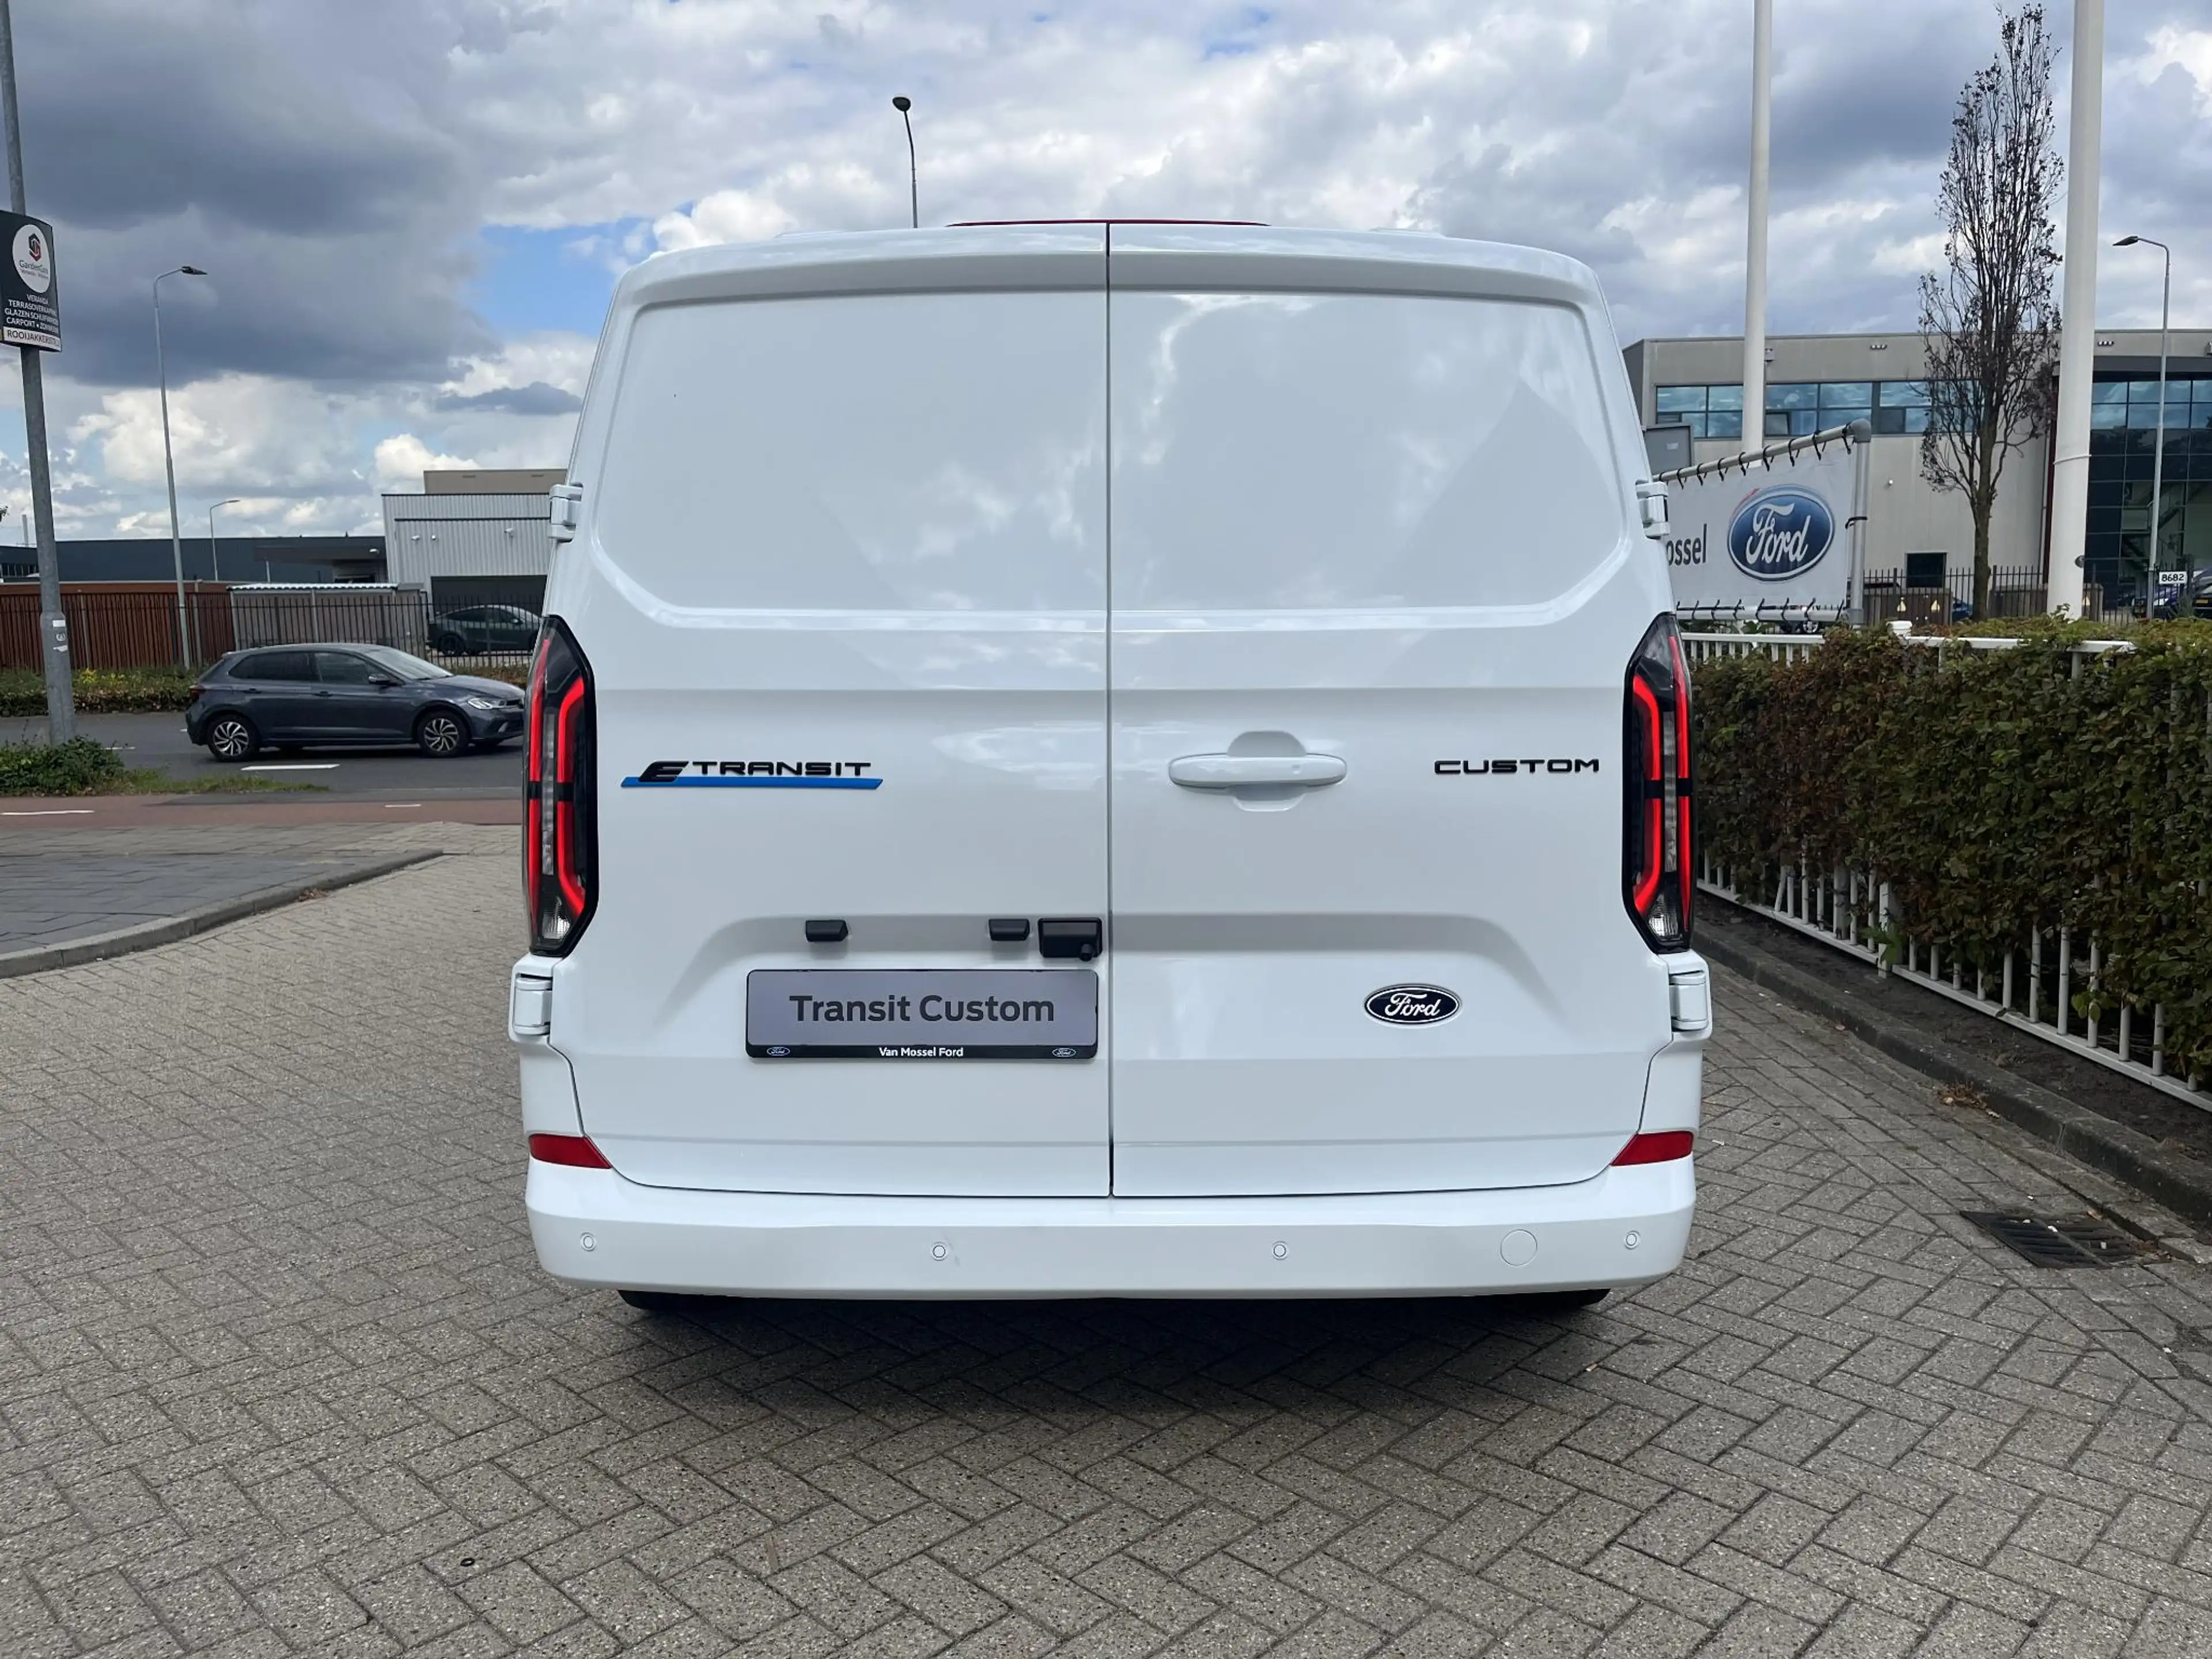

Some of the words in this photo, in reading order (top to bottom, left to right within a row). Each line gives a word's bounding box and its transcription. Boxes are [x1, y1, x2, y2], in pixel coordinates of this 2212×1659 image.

[1666, 523, 1707, 566] ossel
[1745, 503, 1812, 565] Ford
[2161, 574, 2184, 582] 8682
[1434, 759, 1599, 774] CUSTOM
[789, 994, 911, 1022] Transit
[919, 994, 1055, 1022] Custom
[1384, 993, 1442, 1016] Ford
[878, 1047, 898, 1056] Van
[900, 1047, 936, 1056] Mossel
[938, 1047, 964, 1056] Ford
